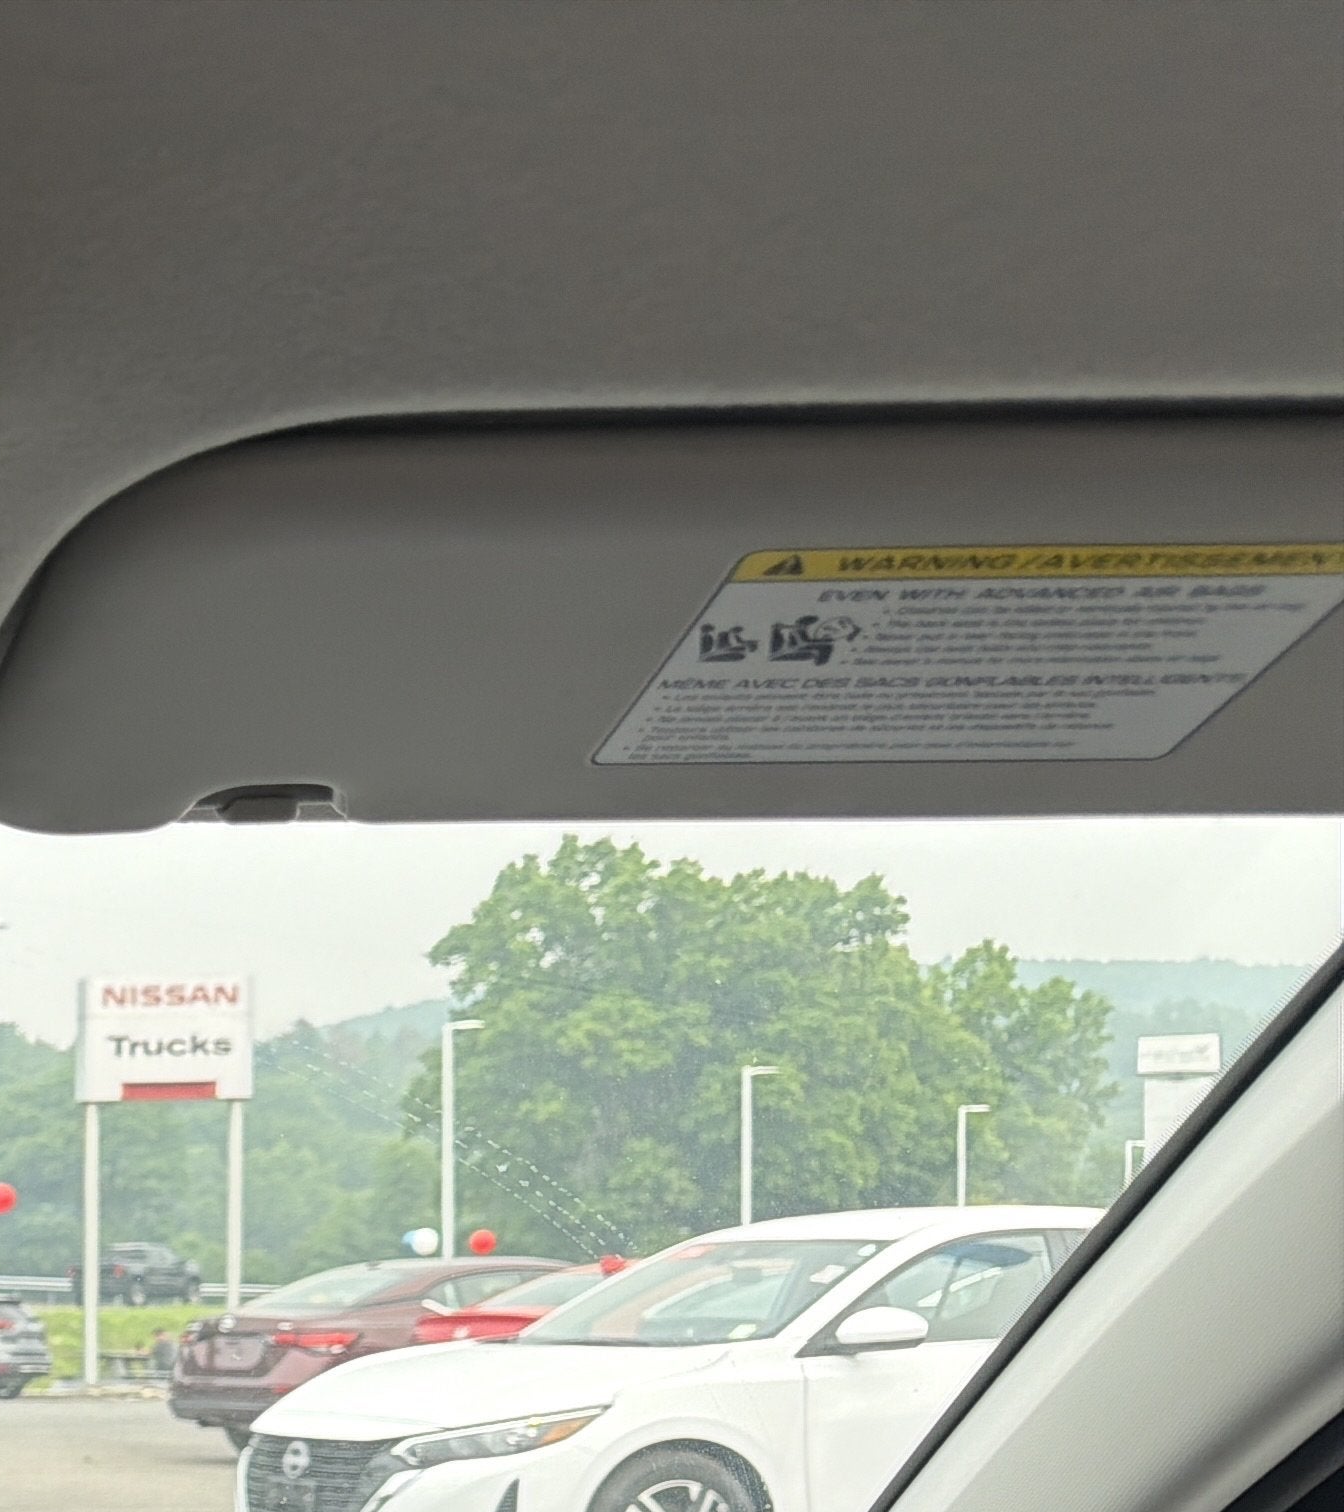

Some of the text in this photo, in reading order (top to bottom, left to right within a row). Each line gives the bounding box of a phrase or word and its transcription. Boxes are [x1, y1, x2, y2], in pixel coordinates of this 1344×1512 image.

[817, 589, 890, 602] EVEN
[898, 588, 969, 601] WITH
[975, 586, 1126, 600] ADVANCED
[734, 677, 800, 689] AVEC
[101, 983, 240, 1007] NISSAN
[107, 1034, 233, 1058] Trucks
